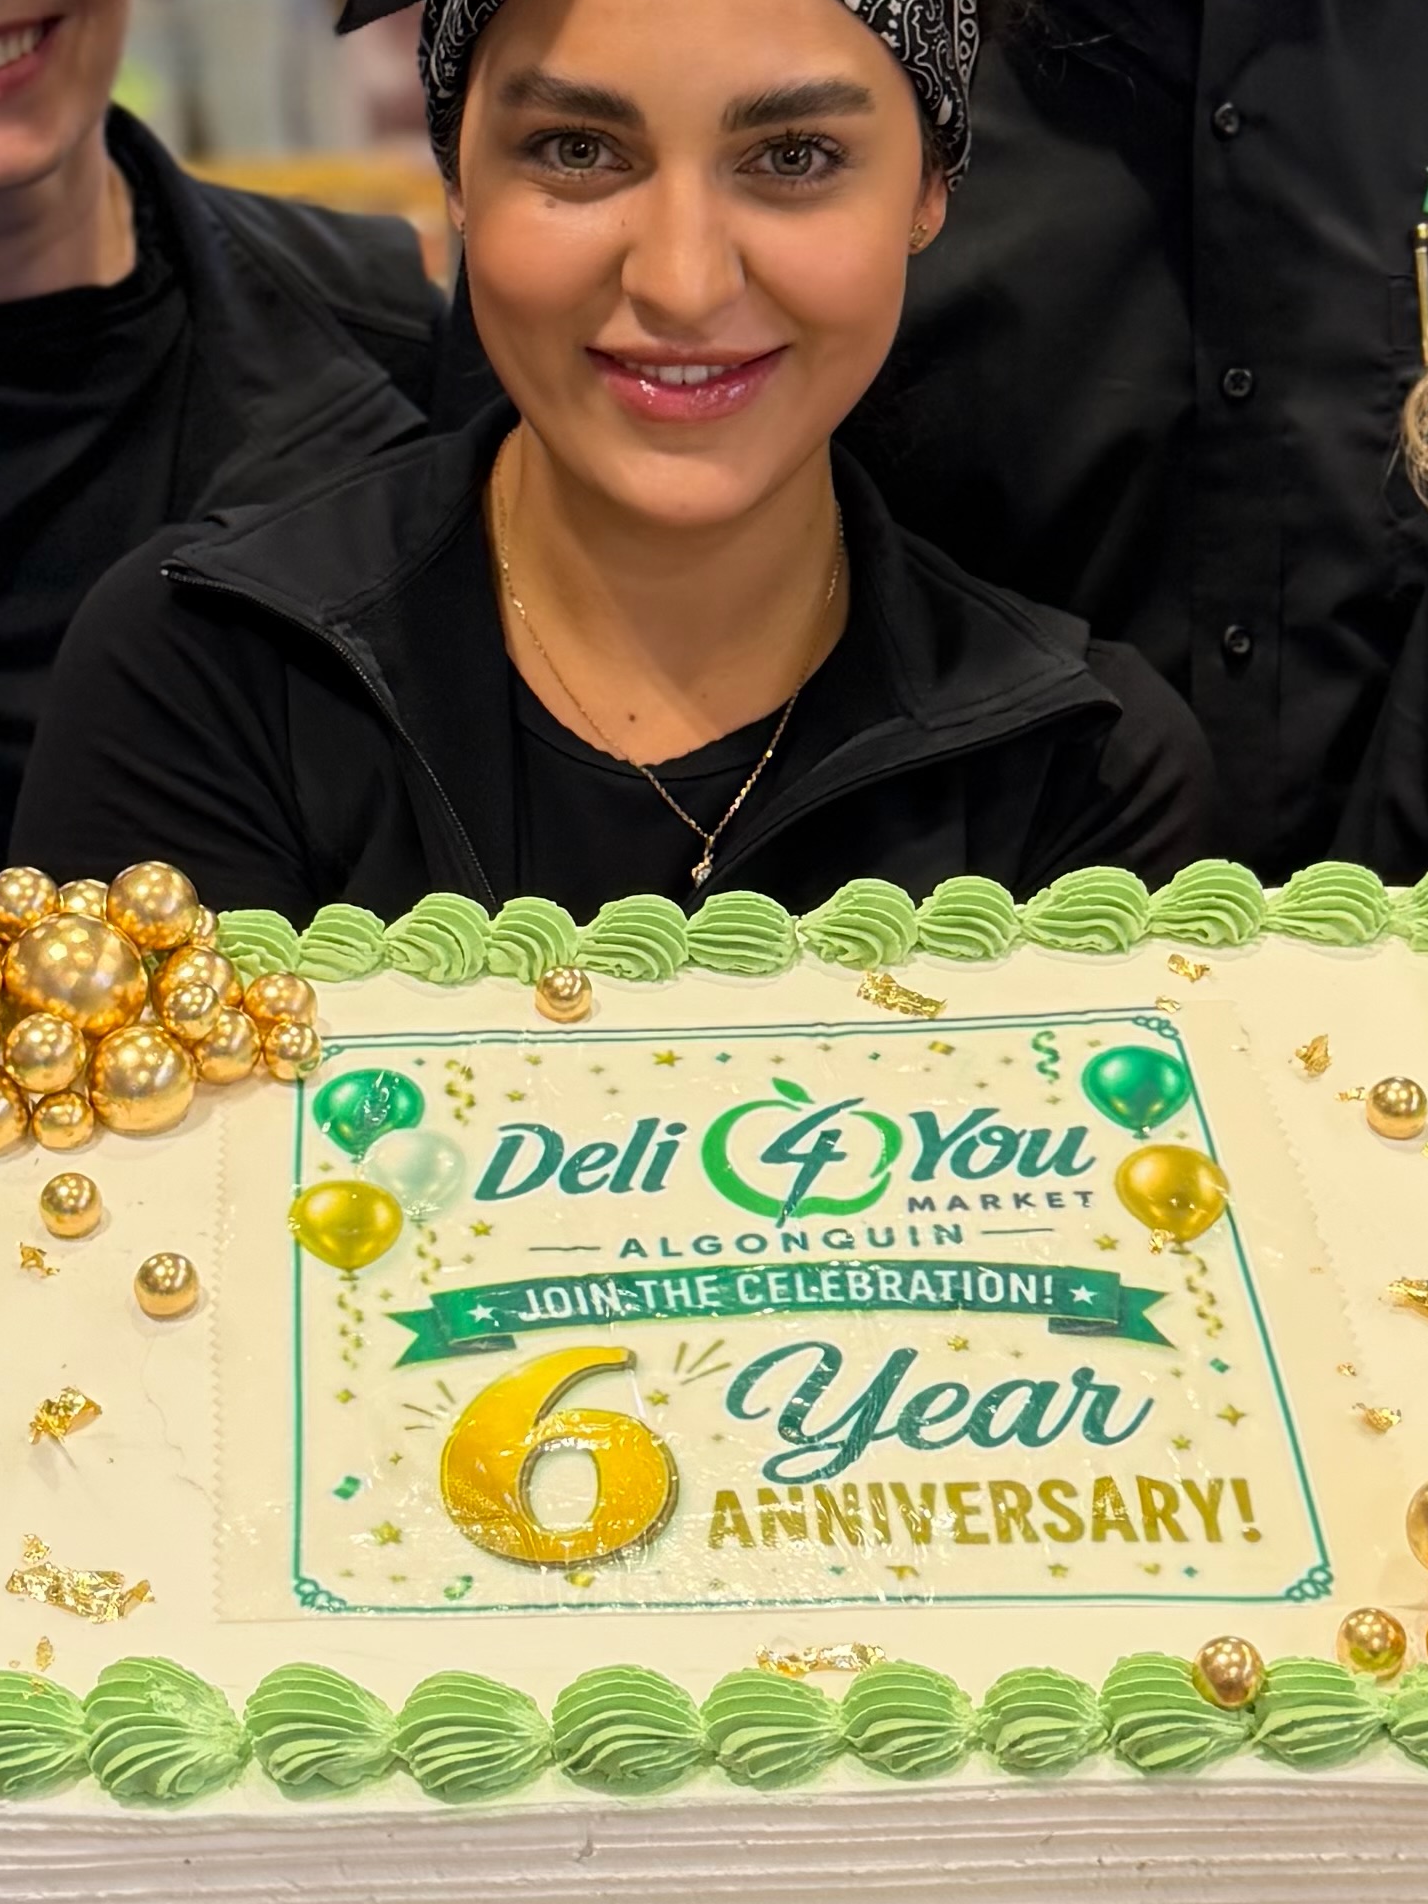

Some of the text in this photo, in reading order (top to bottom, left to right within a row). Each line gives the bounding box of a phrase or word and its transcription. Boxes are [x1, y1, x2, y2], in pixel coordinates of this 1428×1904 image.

[474, 1097, 1097, 1229] Deli 4 You
[907, 1190, 1094, 1213] MARKET
[619, 1223, 965, 1258] ALGONQUIN
[518, 1268, 1054, 1322] JOIN THE CELEBRATION!
[440, 1339, 1155, 1568] 6 Year
[707, 1474, 1263, 1549] ANNIVERSARY!
